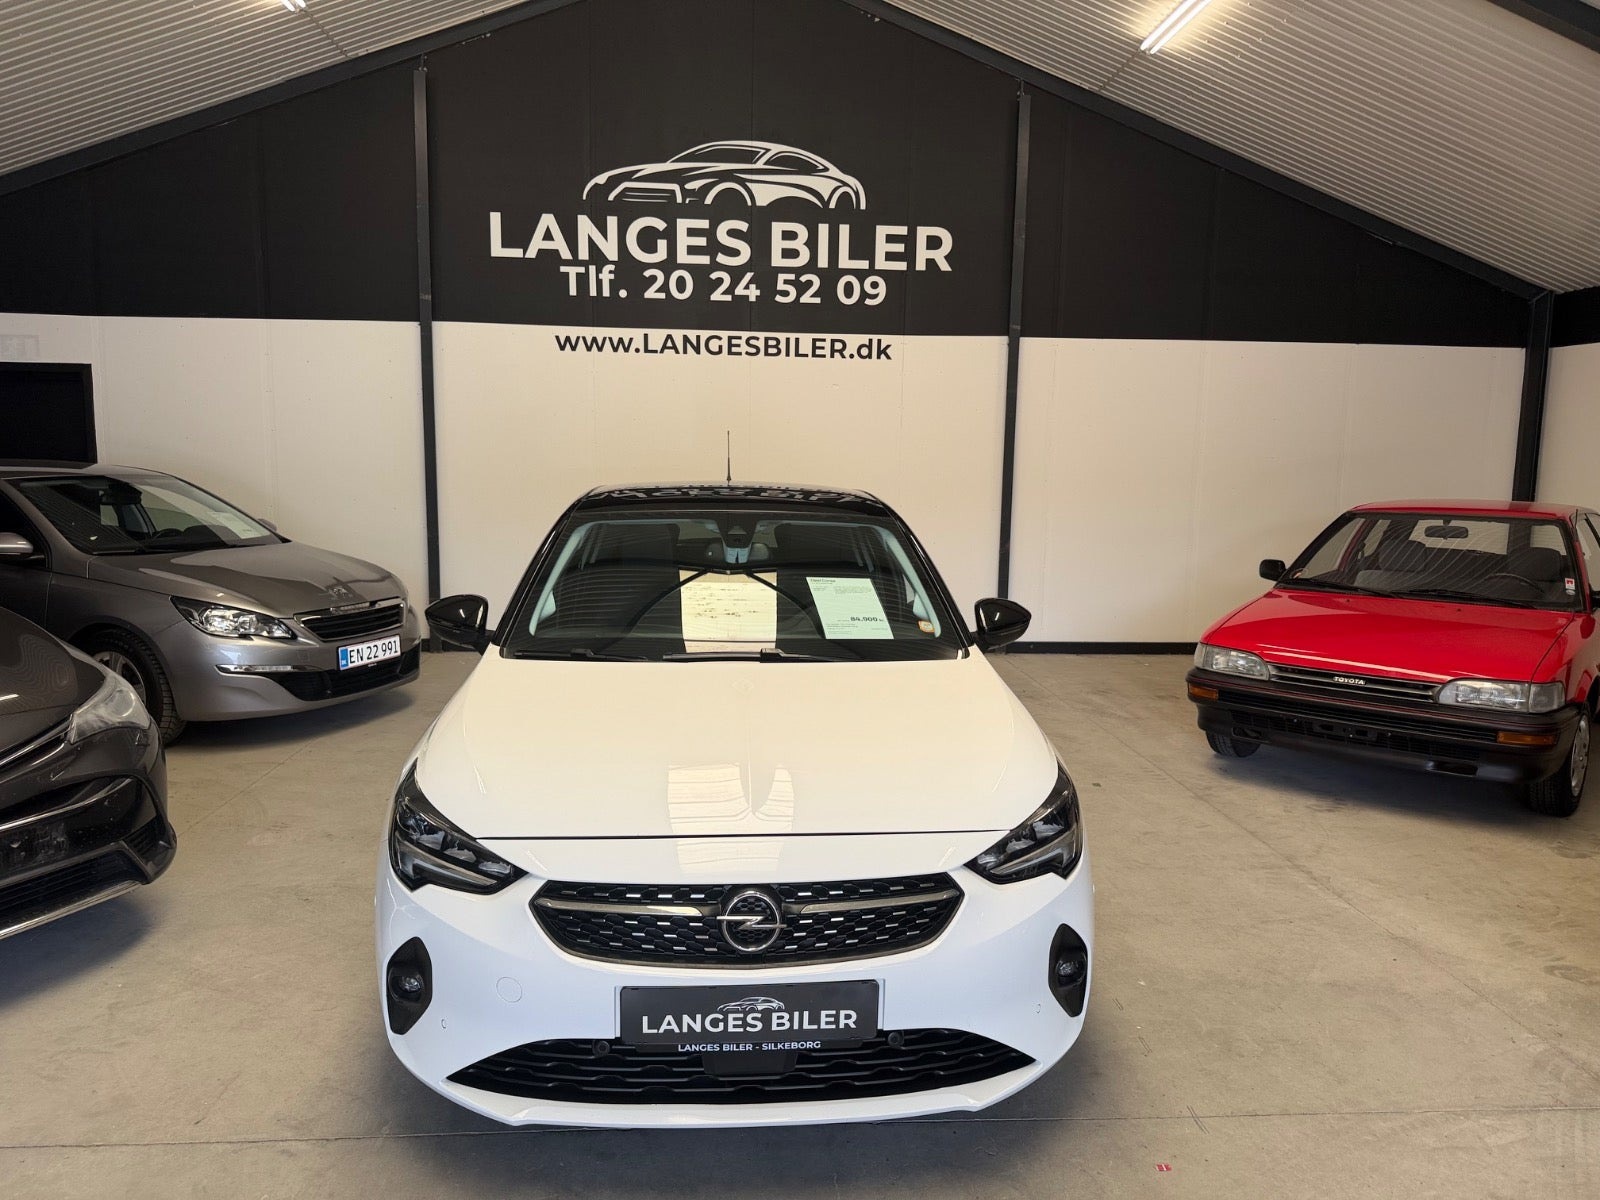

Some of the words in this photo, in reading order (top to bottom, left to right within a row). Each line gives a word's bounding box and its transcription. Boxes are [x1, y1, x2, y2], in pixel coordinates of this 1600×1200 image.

[489, 211, 752, 267] LANGES
[770, 221, 953, 272] BILER
[559, 263, 628, 299] Tlf.
[642, 268, 694, 300] 20
[709, 270, 761, 302] 24
[774, 273, 821, 304] 52
[836, 274, 887, 306] 09
[554, 333, 892, 360] www.LANGESBILER.dk
[349, 647, 364, 664] EN
[366, 644, 379, 660] 22
[381, 640, 398, 657] 991
[1334, 676, 1365, 685] TOYOTA
[642, 1012, 763, 1034] LANGES
[771, 1009, 857, 1031] BILER
[678, 1043, 720, 1052] LANGES
[722, 1043, 753, 1051] BILER
[761, 1040, 821, 1050] SILKEBORG
